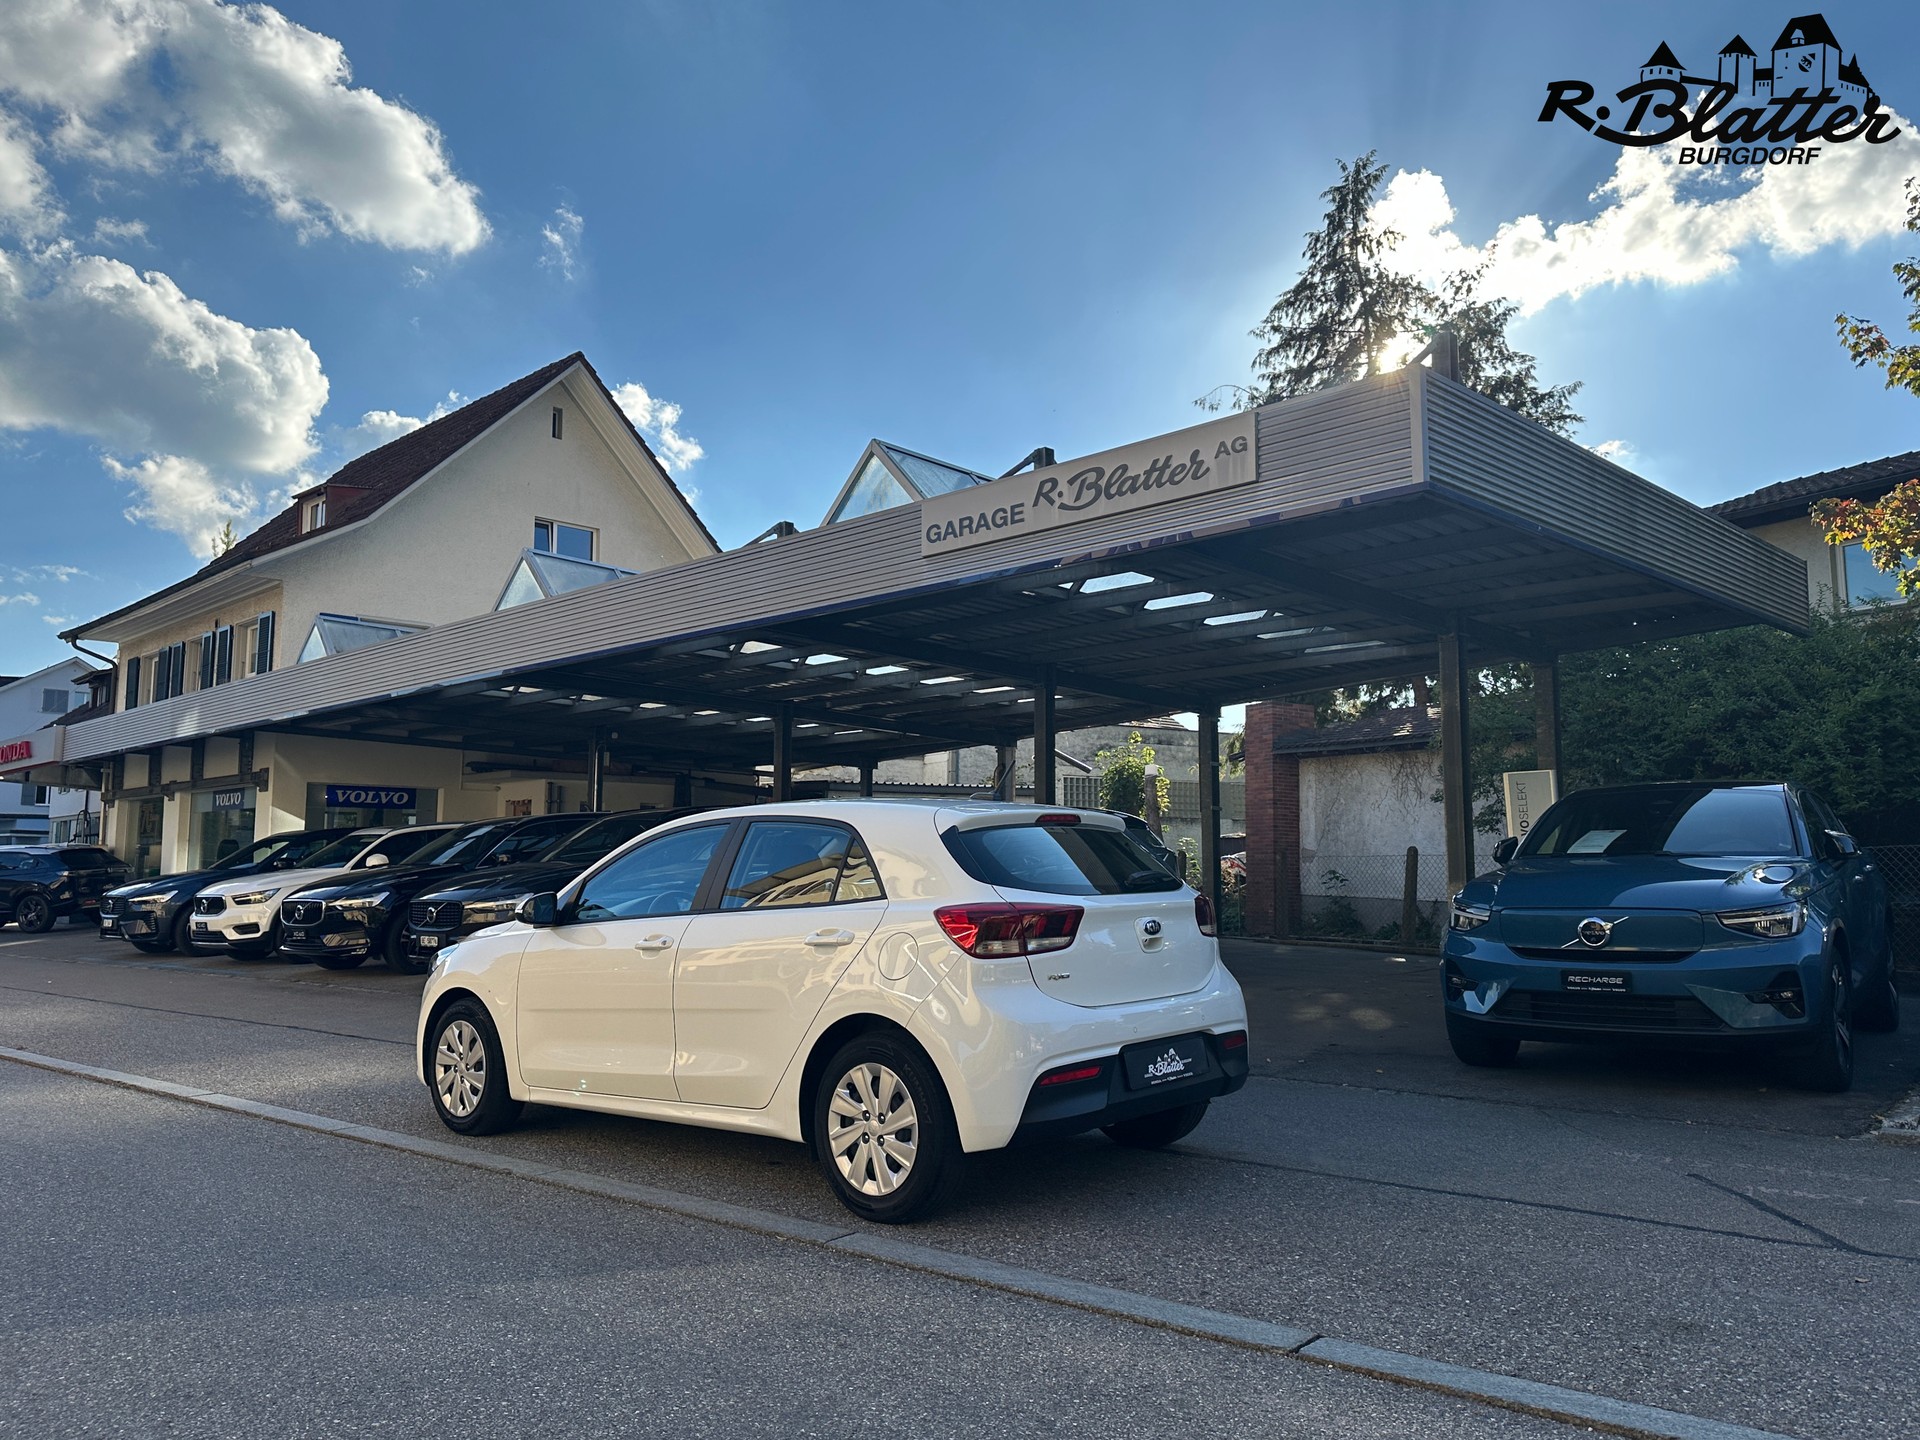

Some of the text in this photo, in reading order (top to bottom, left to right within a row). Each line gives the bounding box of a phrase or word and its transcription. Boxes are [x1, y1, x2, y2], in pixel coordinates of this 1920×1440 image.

[926, 503, 1025, 544] GARAGE
[1214, 436, 1248, 460] AG
[0, 741, 31, 764] ONDA
[215, 792, 242, 806] VOLVO
[336, 790, 409, 804] VOLVO
[1567, 975, 1624, 984] RECHARGE
